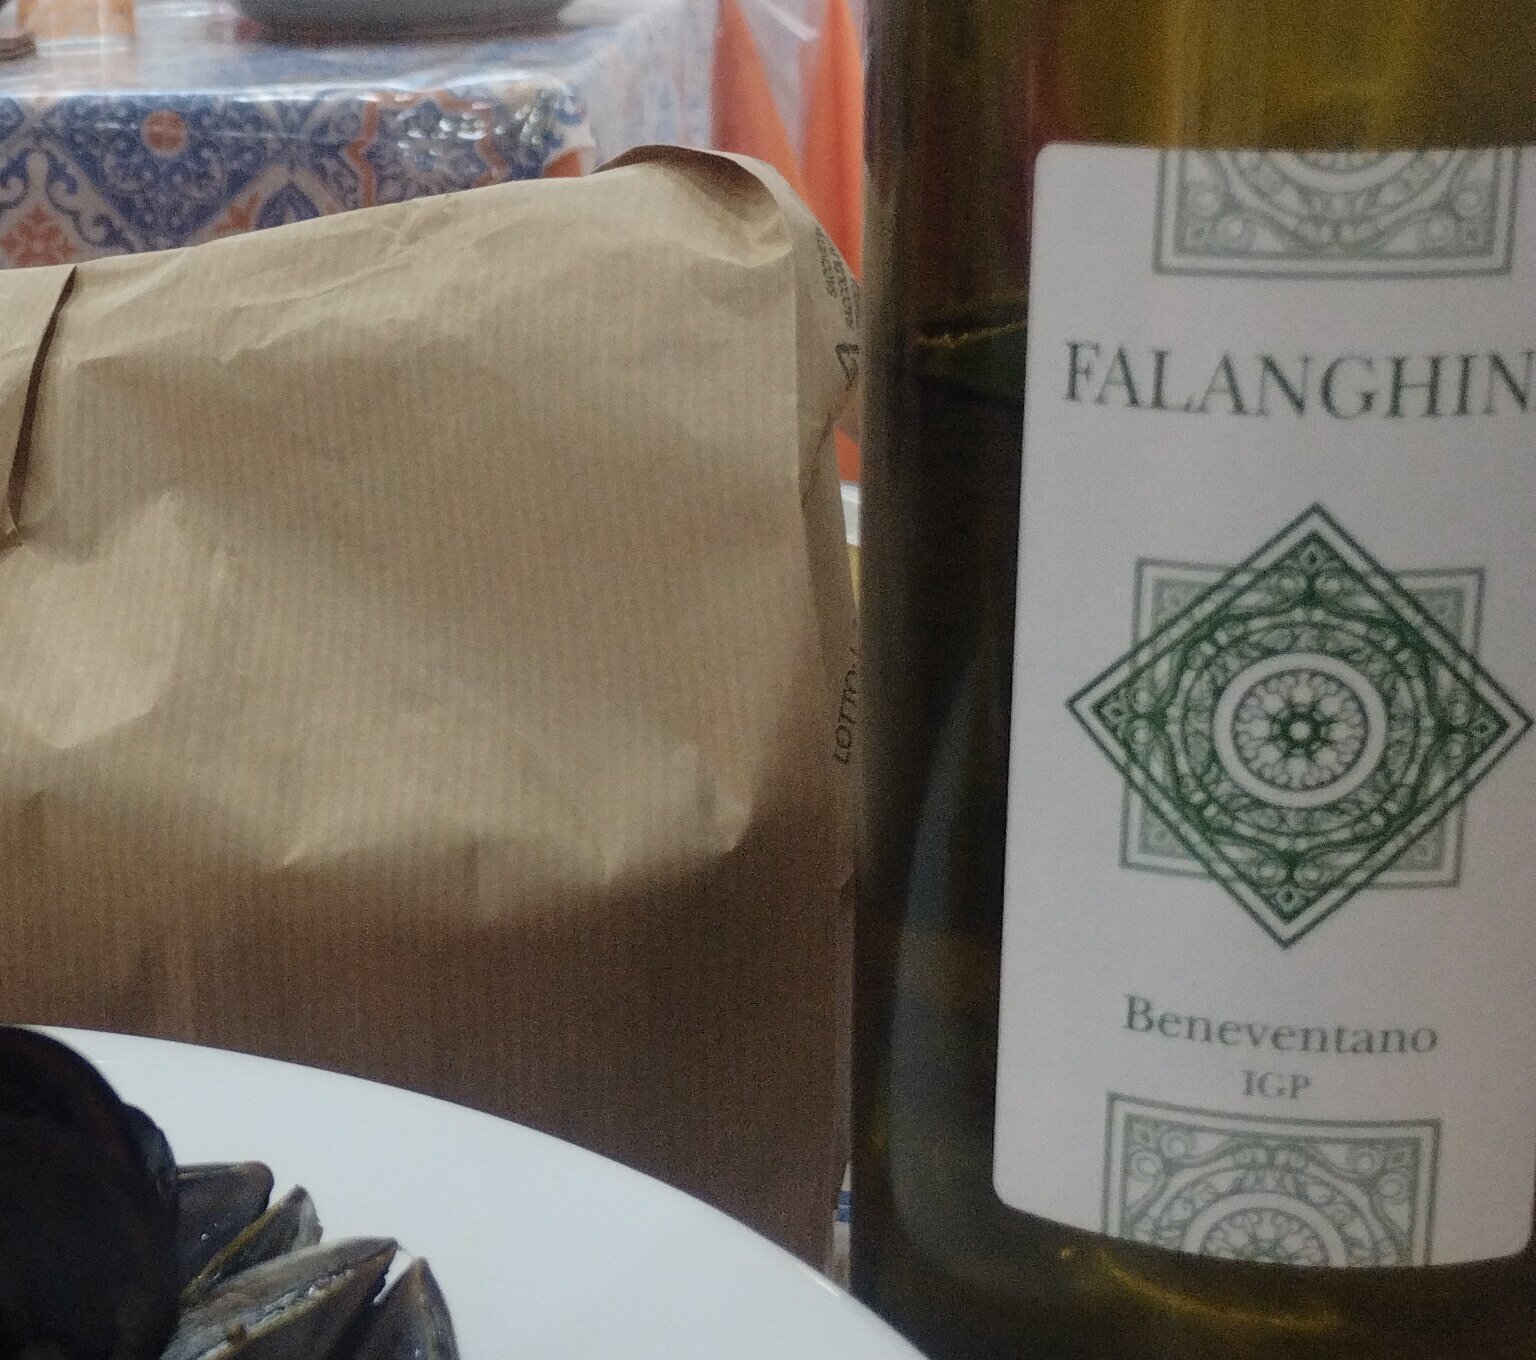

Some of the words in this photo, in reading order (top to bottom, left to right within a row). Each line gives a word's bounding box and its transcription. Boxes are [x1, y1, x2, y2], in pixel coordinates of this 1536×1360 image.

[1064, 338, 1536, 420] FALANGHIN
[1124, 992, 1439, 1055] Beneventano
[1241, 1068, 1312, 1100] IGP
